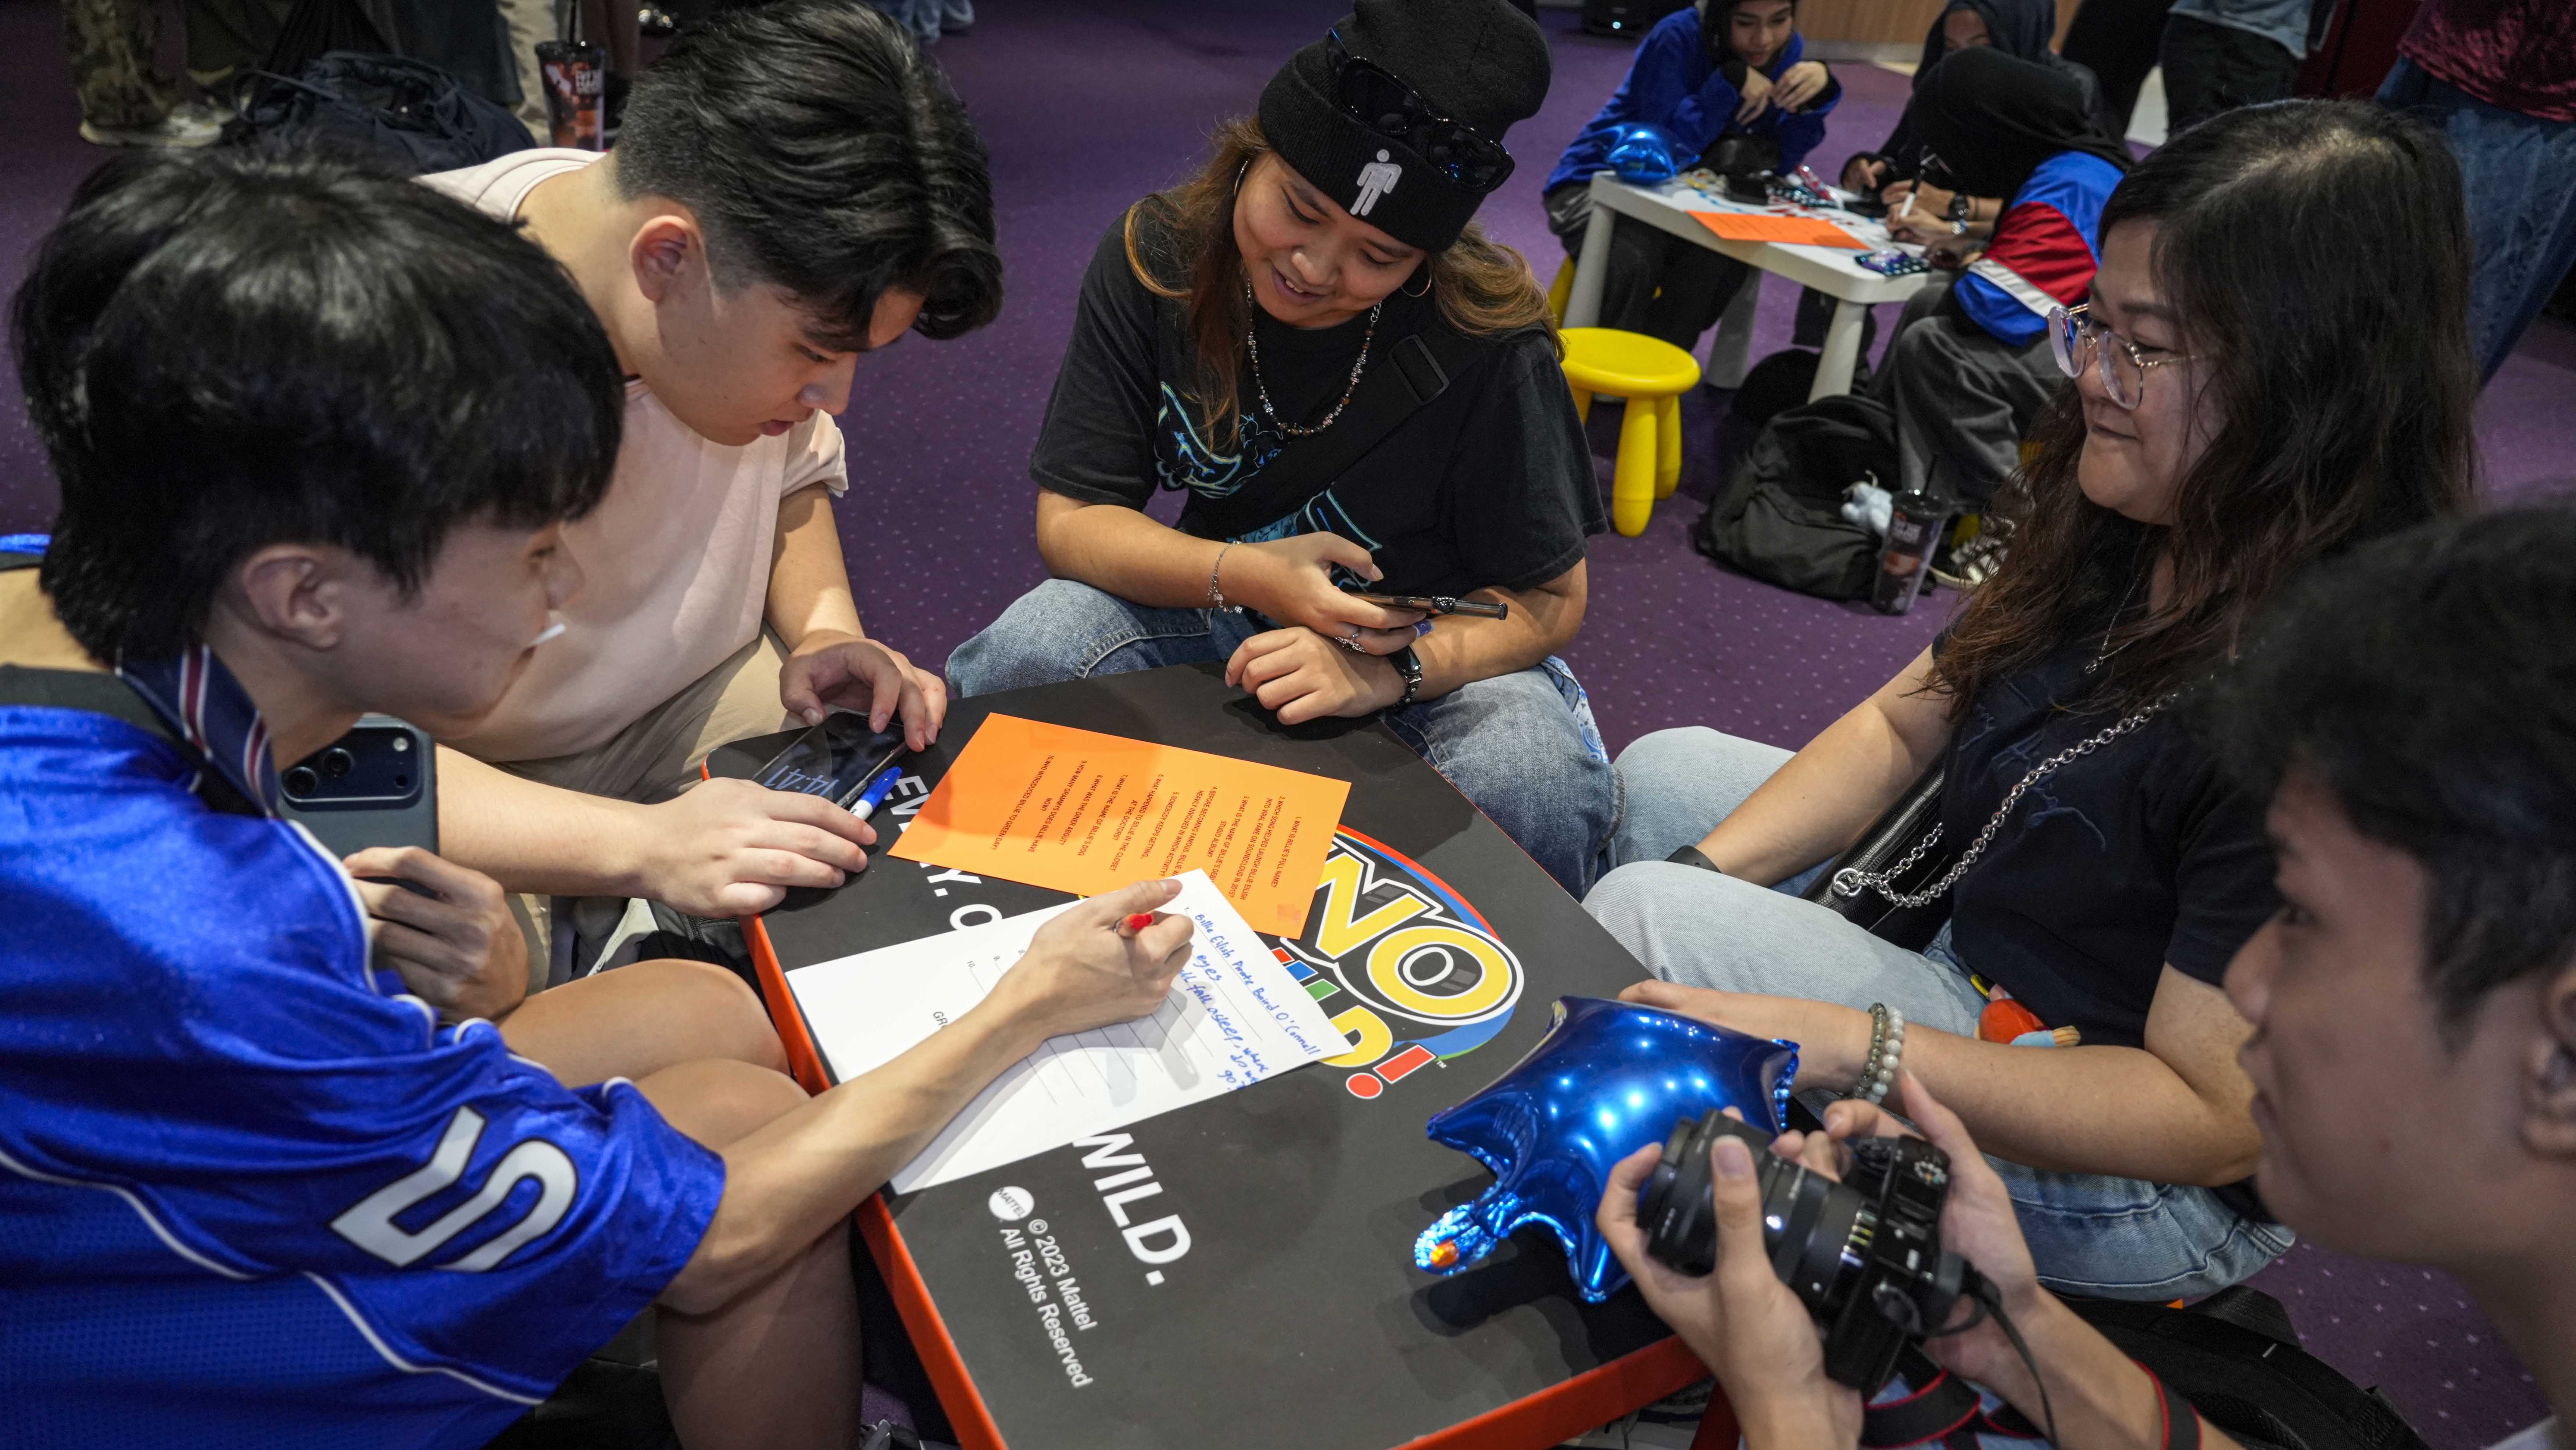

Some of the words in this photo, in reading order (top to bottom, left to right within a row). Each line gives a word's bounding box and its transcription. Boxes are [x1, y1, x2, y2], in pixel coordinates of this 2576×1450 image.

[1074, 764, 1085, 775] HOW
[1022, 770, 1045, 799] INTRODUCED
[1067, 774, 1079, 788] MANY
[1089, 779, 1101, 792] WHAT
[1114, 778, 1126, 791] WHAT
[1151, 778, 1163, 790] WHAT
[1040, 797, 1053, 812] NOW?
[1052, 788, 1071, 811] GRAMMYS
[1083, 792, 1094, 802] WAS
[1106, 795, 1117, 805] THE
[1138, 790, 1156, 814] HAPPENED
[1191, 790, 1205, 808] HEAVILY
[1203, 790, 1217, 808] BEFORE
[1263, 797, 1273, 809] INTO
[1013, 799, 1027, 814] BILLIE
[1077, 802, 1088, 812] THE
[1098, 804, 1111, 819] NAME
[1125, 806, 1136, 816] THE
[1160, 795, 1178, 821] SOMEBODY
[1238, 799, 1249, 813] WHAT
[1273, 800, 1284, 816] WHICH
[1044, 811, 1058, 825] DOES
[1069, 811, 1083, 826] DINER
[1180, 807, 1196, 830] INVOLVED
[1191, 808, 1209, 833] BECOMING
[1231, 818, 1241, 828] THE
[1258, 809, 1269, 822] VIRAL
[1267, 815, 1278, 829] SONG
[998, 820, 1013, 838] GREEN
[1035, 824, 1049, 839] BILLIE
[1084, 825, 1100, 845] BILLIE'S
[1112, 815, 1130, 841] DOCTORS?
[1127, 821, 1140, 836] BILLIE
[1152, 821, 1165, 837] KEEPS
[1214, 820, 1228, 838] STUDIO
[1225, 827, 1237, 842] NAME
[1252, 822, 1263, 836] FAME
[1290, 820, 1301, 834] WHAT
[990, 837, 1003, 850] DAY?
[1058, 826, 1073, 846] ABOUT?
[1249, 835, 1258, 843] ON
[1260, 829, 1273, 848] HELPED
[1027, 839, 1040, 853] HAVE
[1077, 844, 1089, 856] DOG
[1118, 842, 1130, 852] THE
[1170, 836, 1183, 853] WHICH
[1206, 837, 1220, 858] ALBUM?
[1223, 841, 1231, 849] OF
[1281, 838, 1294, 858] BILLIE'S
[1109, 851, 1124, 872] CLOSET
[1158, 851, 1175, 877] ACTIVITY?
[1174, 854, 1187, 870] BILLIE
[1214, 848, 1228, 868] BILLIE'S
[1236, 843, 1255, 877] SOUNDCLOUD
[1252, 847, 1266, 869] LAUNCH
[1276, 857, 1287, 870] FULL
[1245, 868, 1258, 884] BILLIE
[1270, 870, 1282, 888] NAME?
[1227, 883, 1239, 898] 2015?
[1239, 883, 1252, 901] EILISH
[1195, 914, 1213, 934] Billie
[1210, 936, 1235, 958] Eilish
[1314, 840, 1513, 1018] NO
[1192, 955, 1222, 981] eyes
[1186, 985, 1213, 1004] fall
[1072, 1133, 1191, 1286] WILD.
[999, 1229, 1026, 1249] All
[1011, 1249, 1047, 1303] Rights
[1035, 1235, 1070, 1277] 2023
[1056, 1277, 1098, 1331] Mattel
[1037, 1303, 1094, 1388] Reserved
